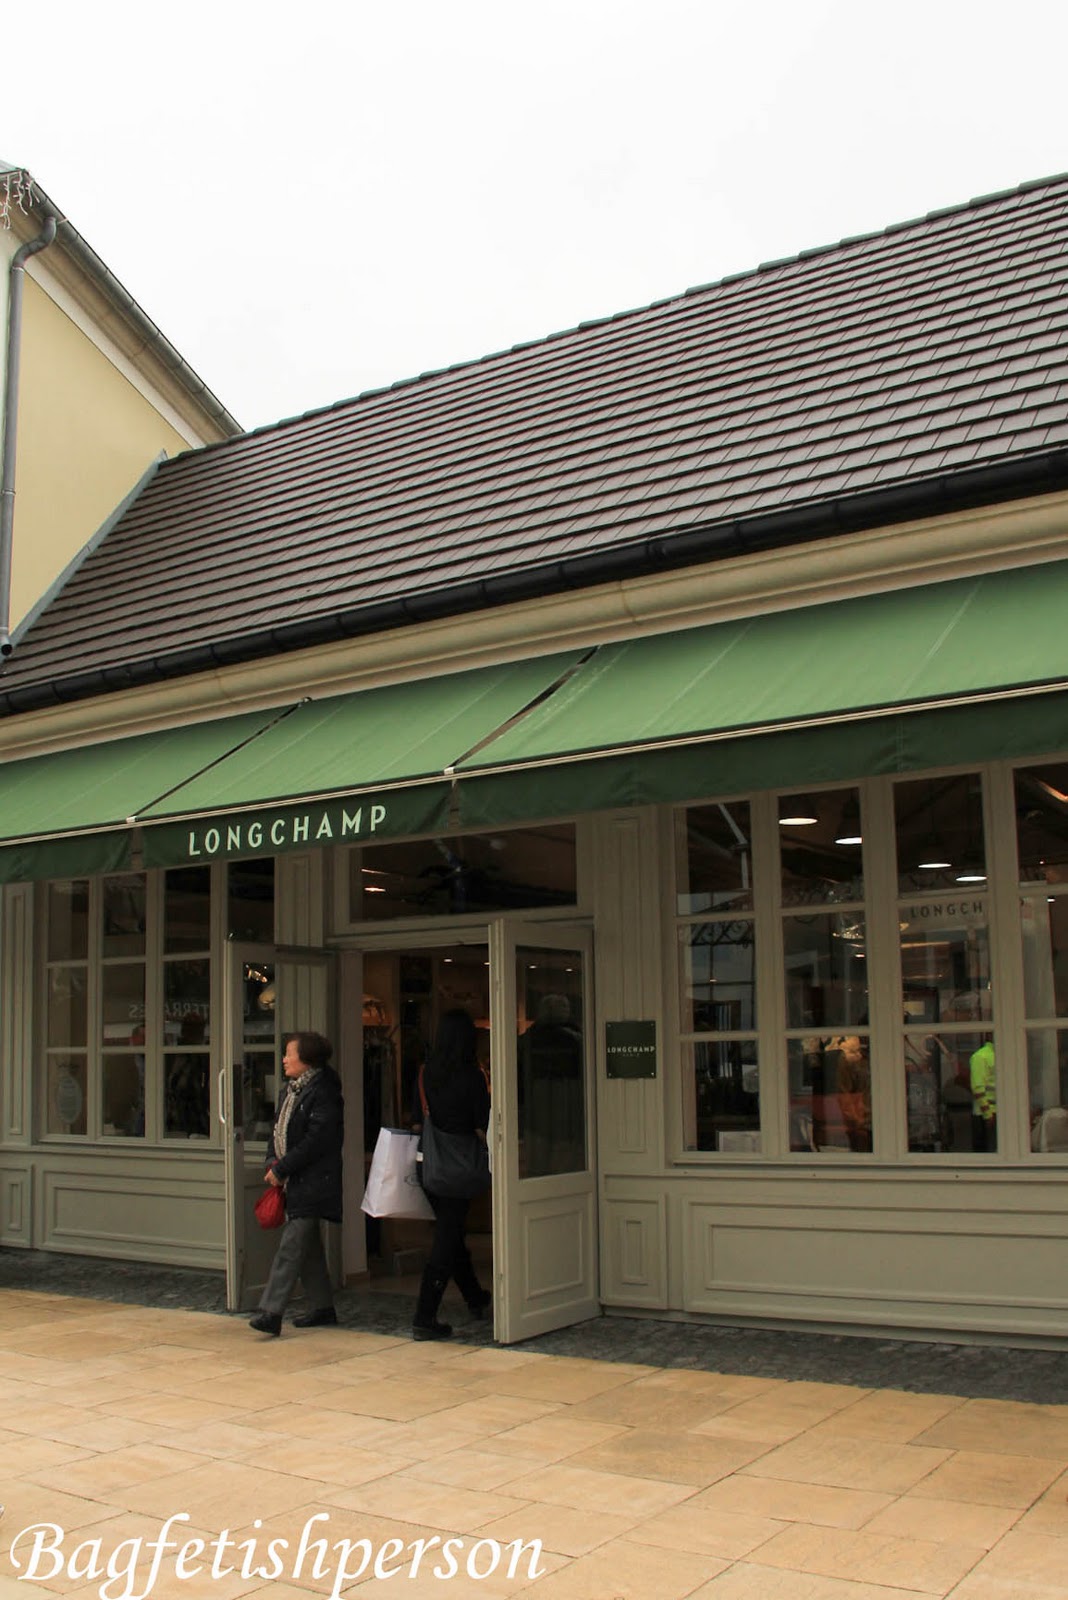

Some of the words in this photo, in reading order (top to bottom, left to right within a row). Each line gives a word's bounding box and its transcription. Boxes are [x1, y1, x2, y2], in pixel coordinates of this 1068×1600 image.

[189, 805, 386, 855] LONGCHAMP
[911, 901, 984, 918] LONGCH
[607, 1045, 655, 1053] LONGCHAMP
